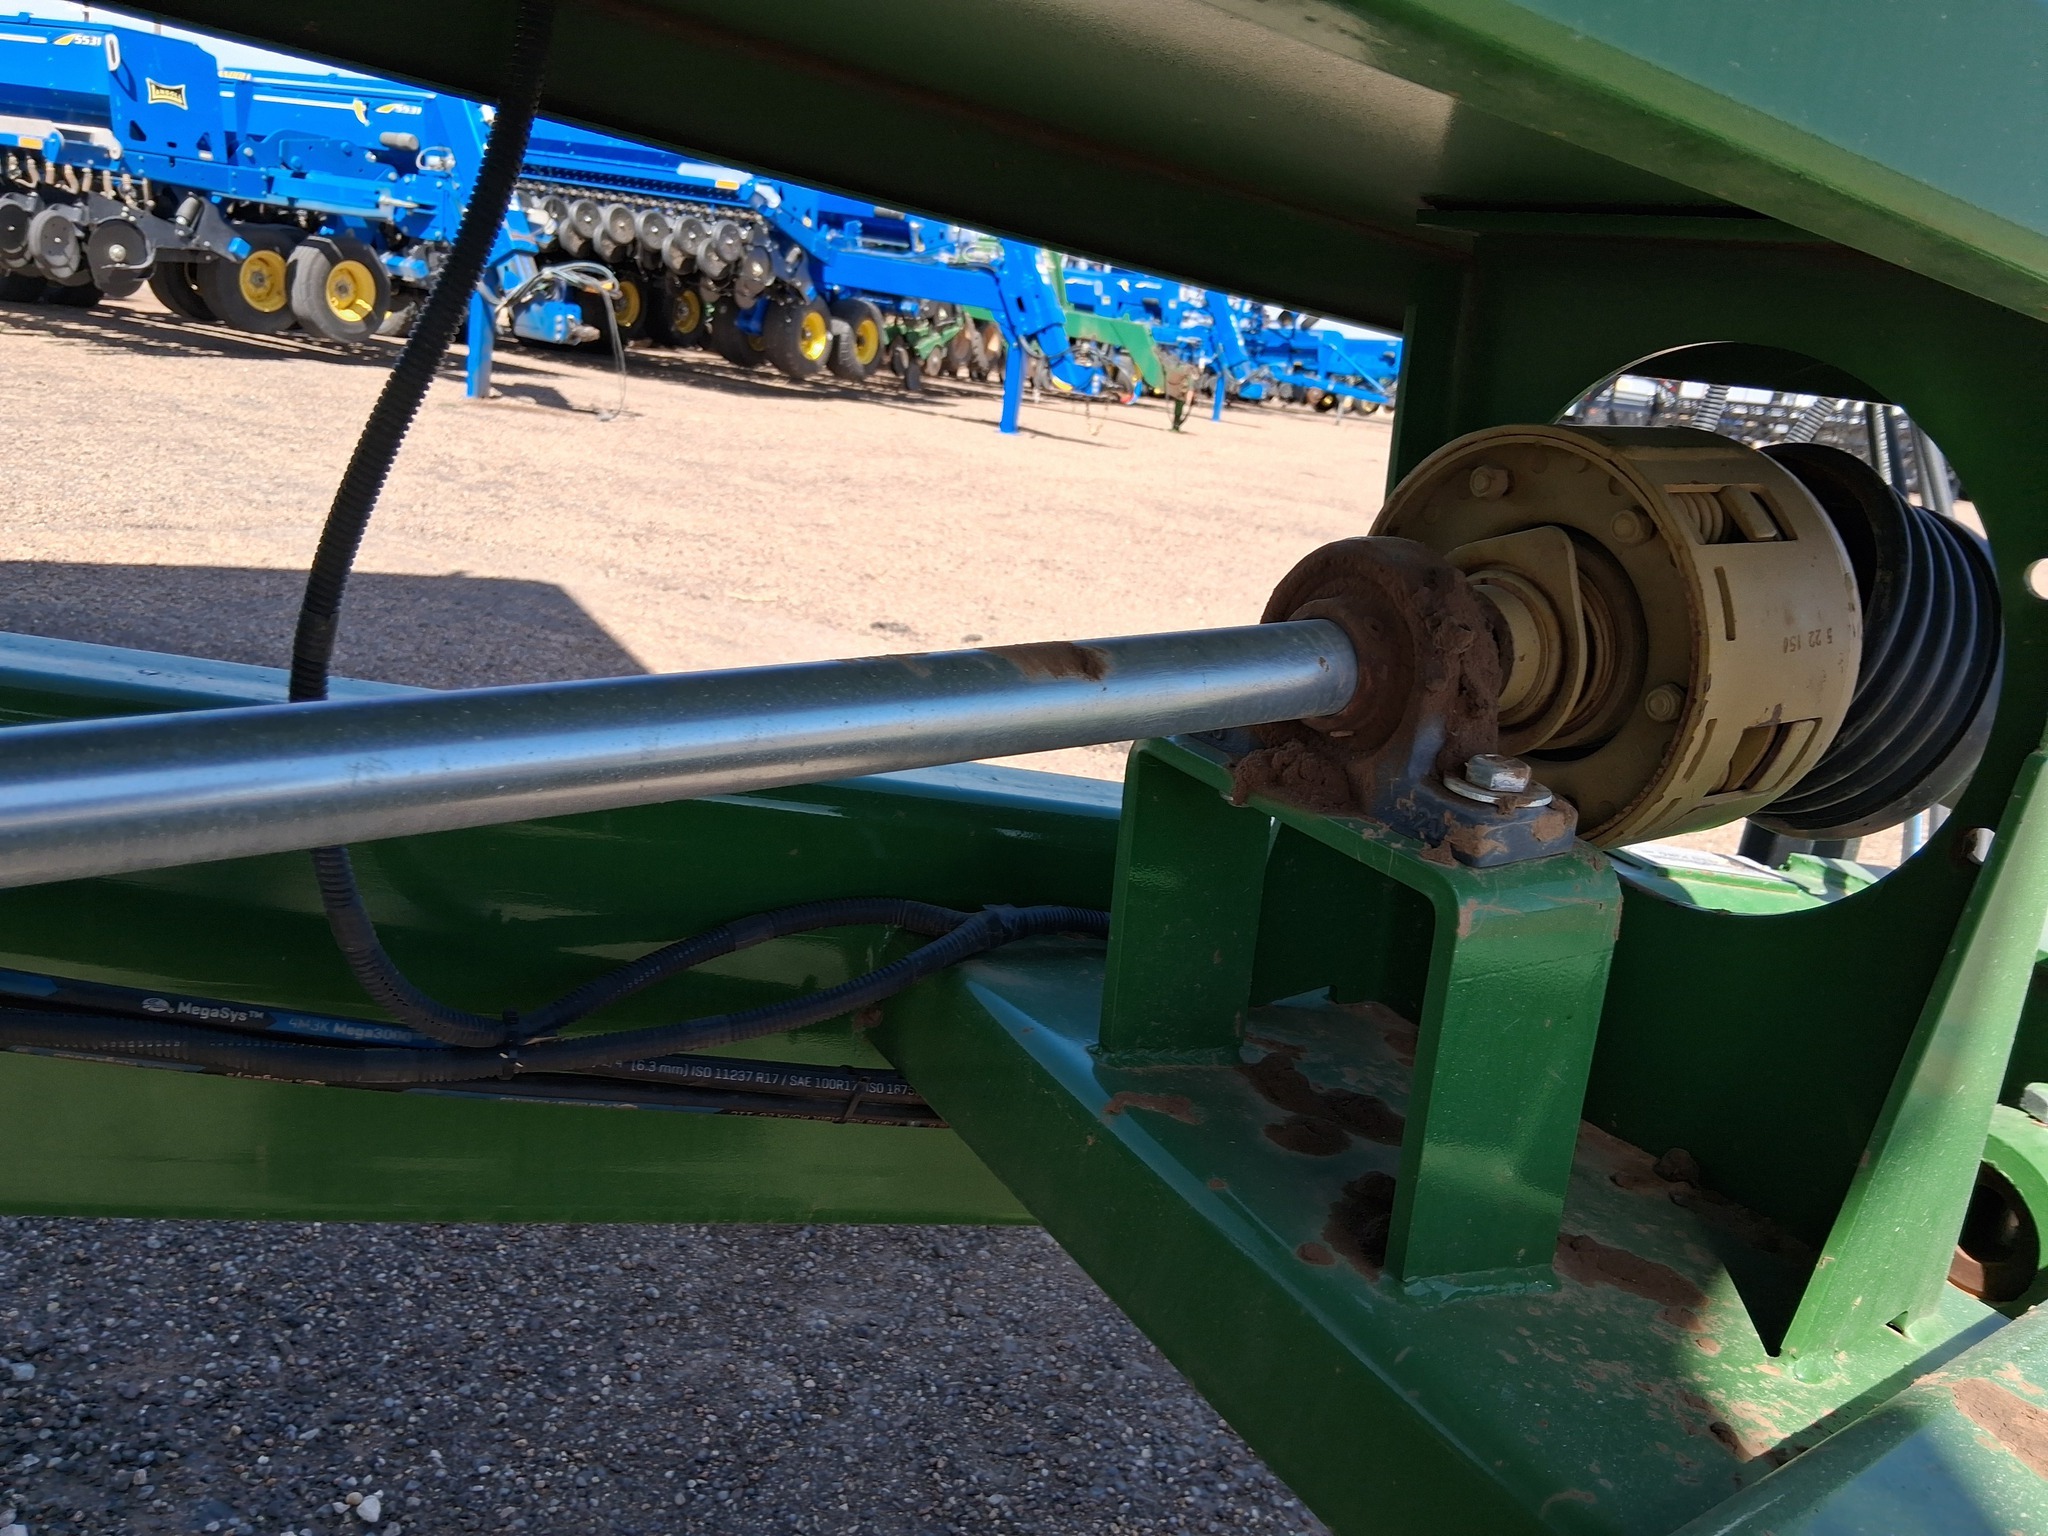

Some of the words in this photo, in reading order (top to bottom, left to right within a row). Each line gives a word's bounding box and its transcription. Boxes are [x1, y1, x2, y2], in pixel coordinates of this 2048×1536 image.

[73, 34, 102, 47] 5531
[691, 1065, 712, 1079] ISO
[715, 1068, 753, 1082] 11237
[756, 1071, 780, 1085] R17
[789, 1075, 812, 1088] SAE
[886, 1083, 918, 1097] 1875
